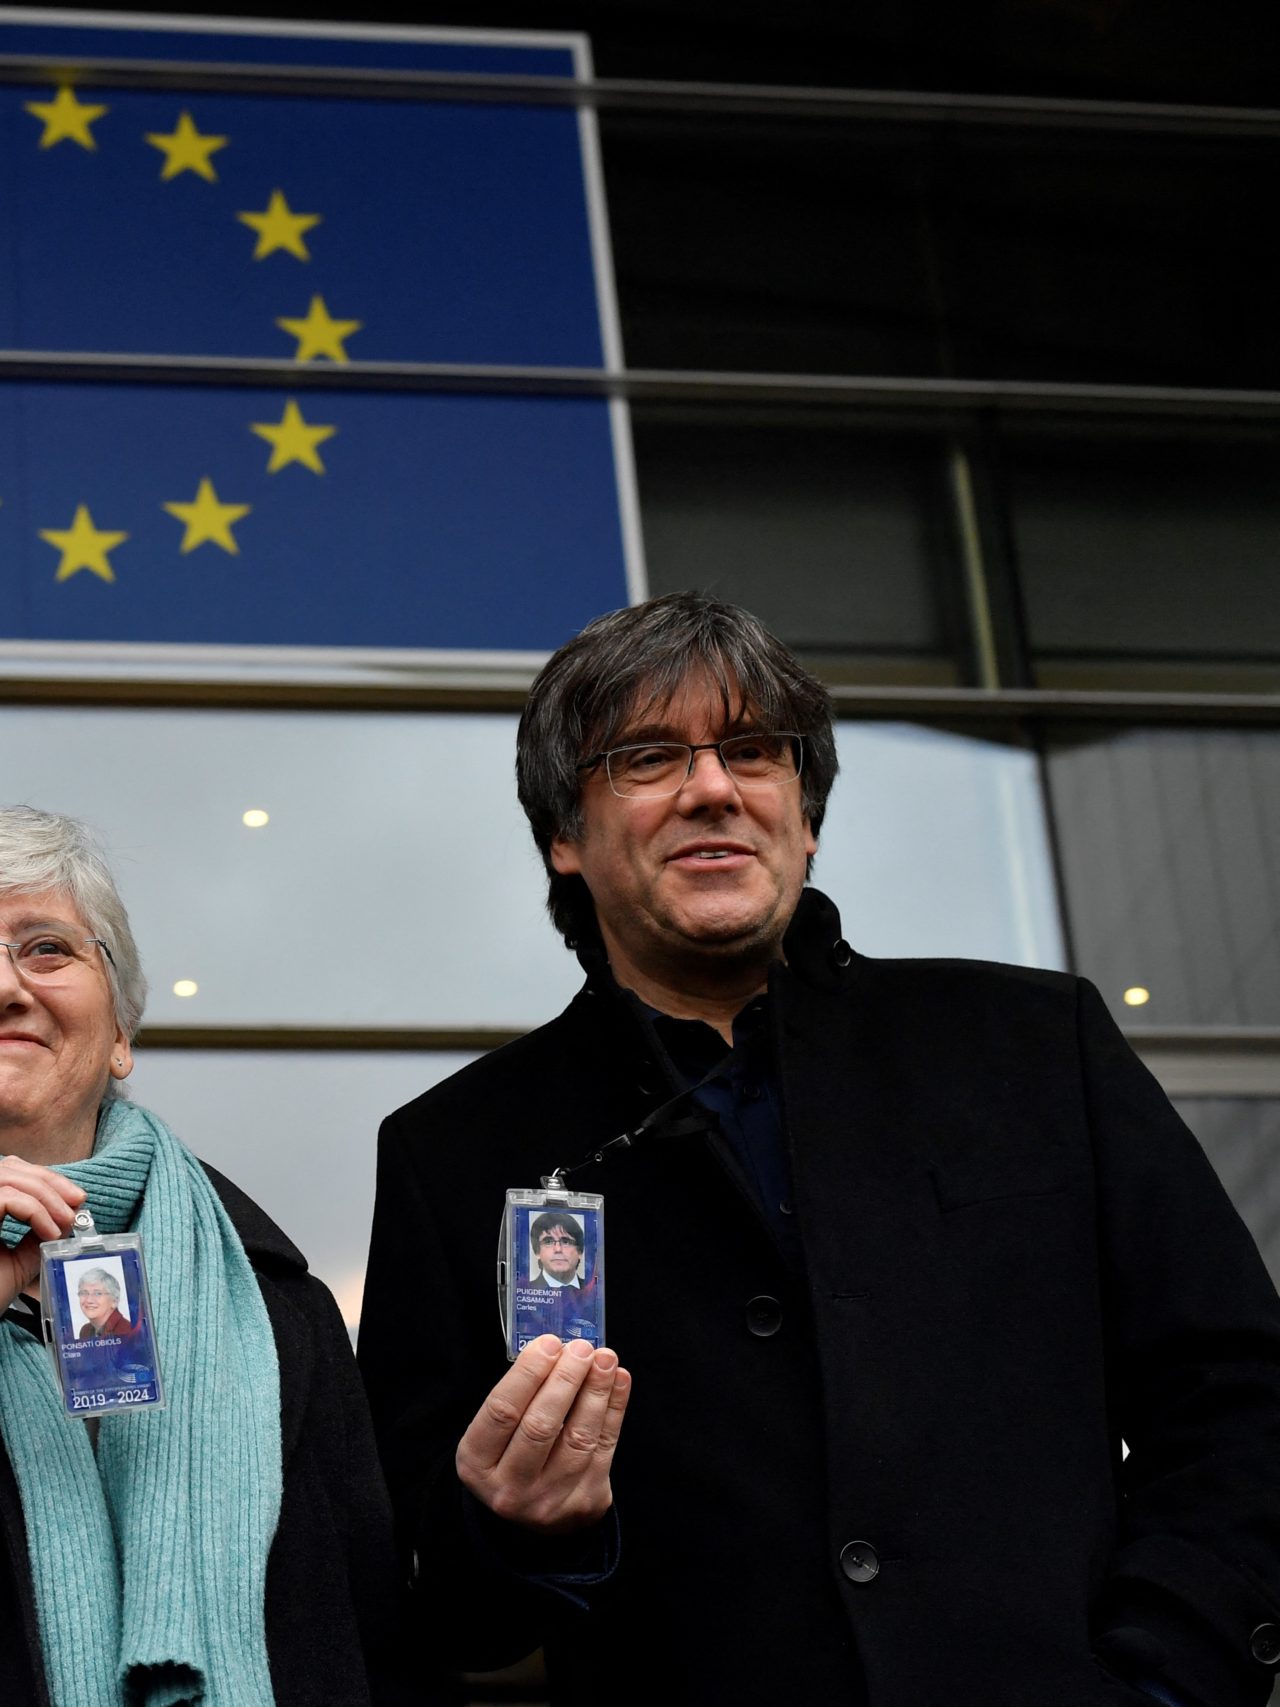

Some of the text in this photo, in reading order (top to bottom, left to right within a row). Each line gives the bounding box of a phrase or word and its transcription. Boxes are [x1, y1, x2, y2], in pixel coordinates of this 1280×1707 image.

[517, 1288, 562, 1297] PUIGDEMONT
[95, 1338, 121, 1347] OBIOLS
[73, 1393, 106, 1409] 2019
[117, 1389, 149, 1404] 2024
